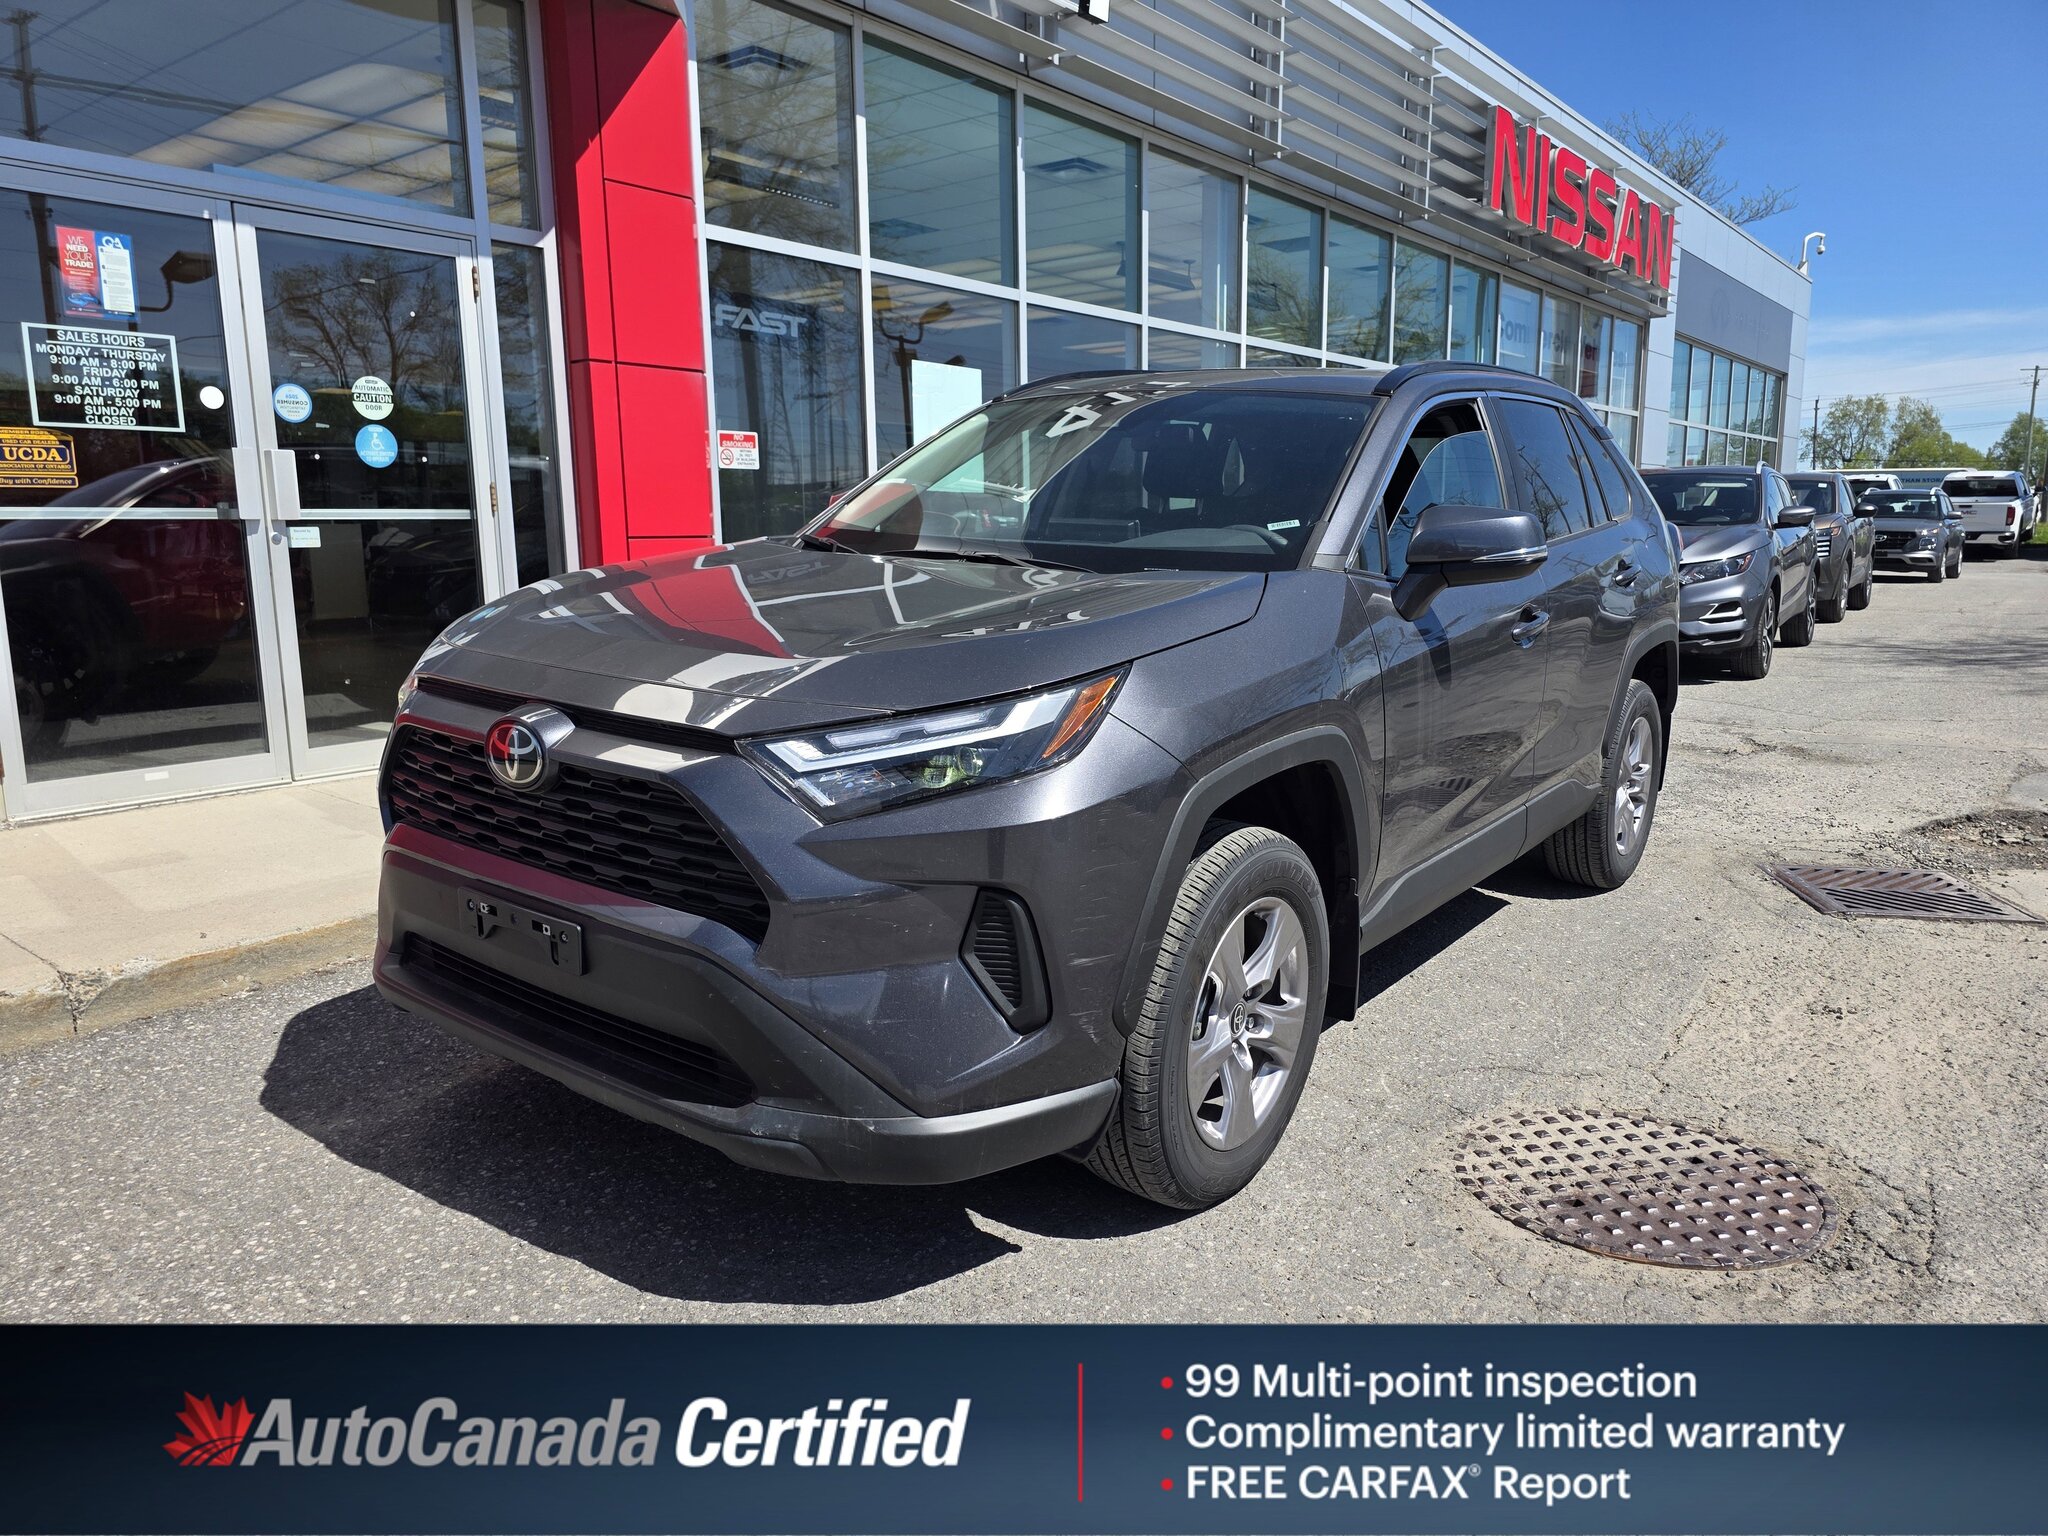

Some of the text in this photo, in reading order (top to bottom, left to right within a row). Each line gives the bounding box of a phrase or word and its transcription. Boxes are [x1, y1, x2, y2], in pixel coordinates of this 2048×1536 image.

[1487, 104, 1674, 290] NISSAN
[67, 235, 85, 245] WE
[66, 243, 89, 252] NEED
[64, 250, 93, 261] YOUR
[64, 259, 94, 268] TRADE!
[714, 304, 807, 337] FAST
[57, 330, 145, 347] SALES HOURS
[36, 344, 90, 356] MONDAY
[101, 348, 166, 362] THURSDAY
[50, 355, 76, 365] 9:00
[80, 358, 99, 367] AM
[111, 359, 135, 369] 8:00
[138, 362, 157, 371] PM
[83, 367, 127, 378] FRIDAY
[52, 374, 78, 384] 9:00
[82, 377, 101, 386] AM
[113, 379, 138, 388] 6:00
[141, 381, 159, 390] PM
[75, 386, 140, 398] SATURDAY
[354, 384, 389, 392] AUTOMATIC
[54, 394, 81, 404] 9:00
[84, 396, 104, 406] AM
[115, 398, 140, 408] 5:00
[143, 400, 161, 409] PM
[353, 393, 392, 403] CAUTION
[85, 406, 134, 416] SUNDAY
[86, 415, 136, 426] CLOSED
[722, 440, 754, 448] SMOKING
[2, 447, 63, 461] UCDA
